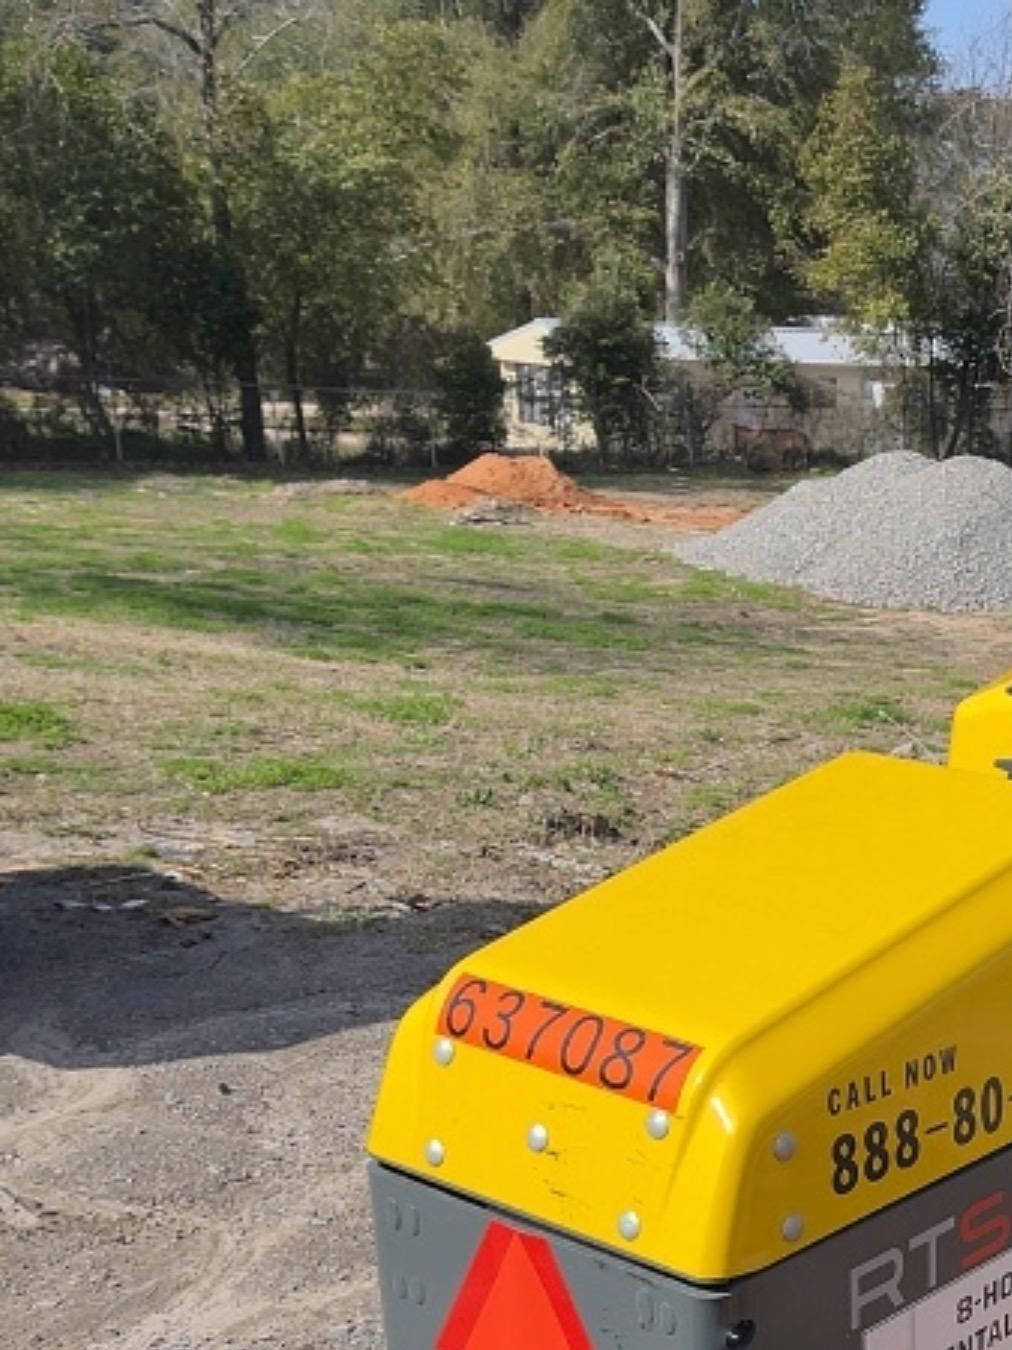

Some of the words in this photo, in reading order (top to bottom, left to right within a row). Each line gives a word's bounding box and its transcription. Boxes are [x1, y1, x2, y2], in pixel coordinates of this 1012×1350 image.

[445, 979, 694, 1102] 637087
[827, 1069, 892, 1116] CALL
[905, 1045, 957, 1089] NOW
